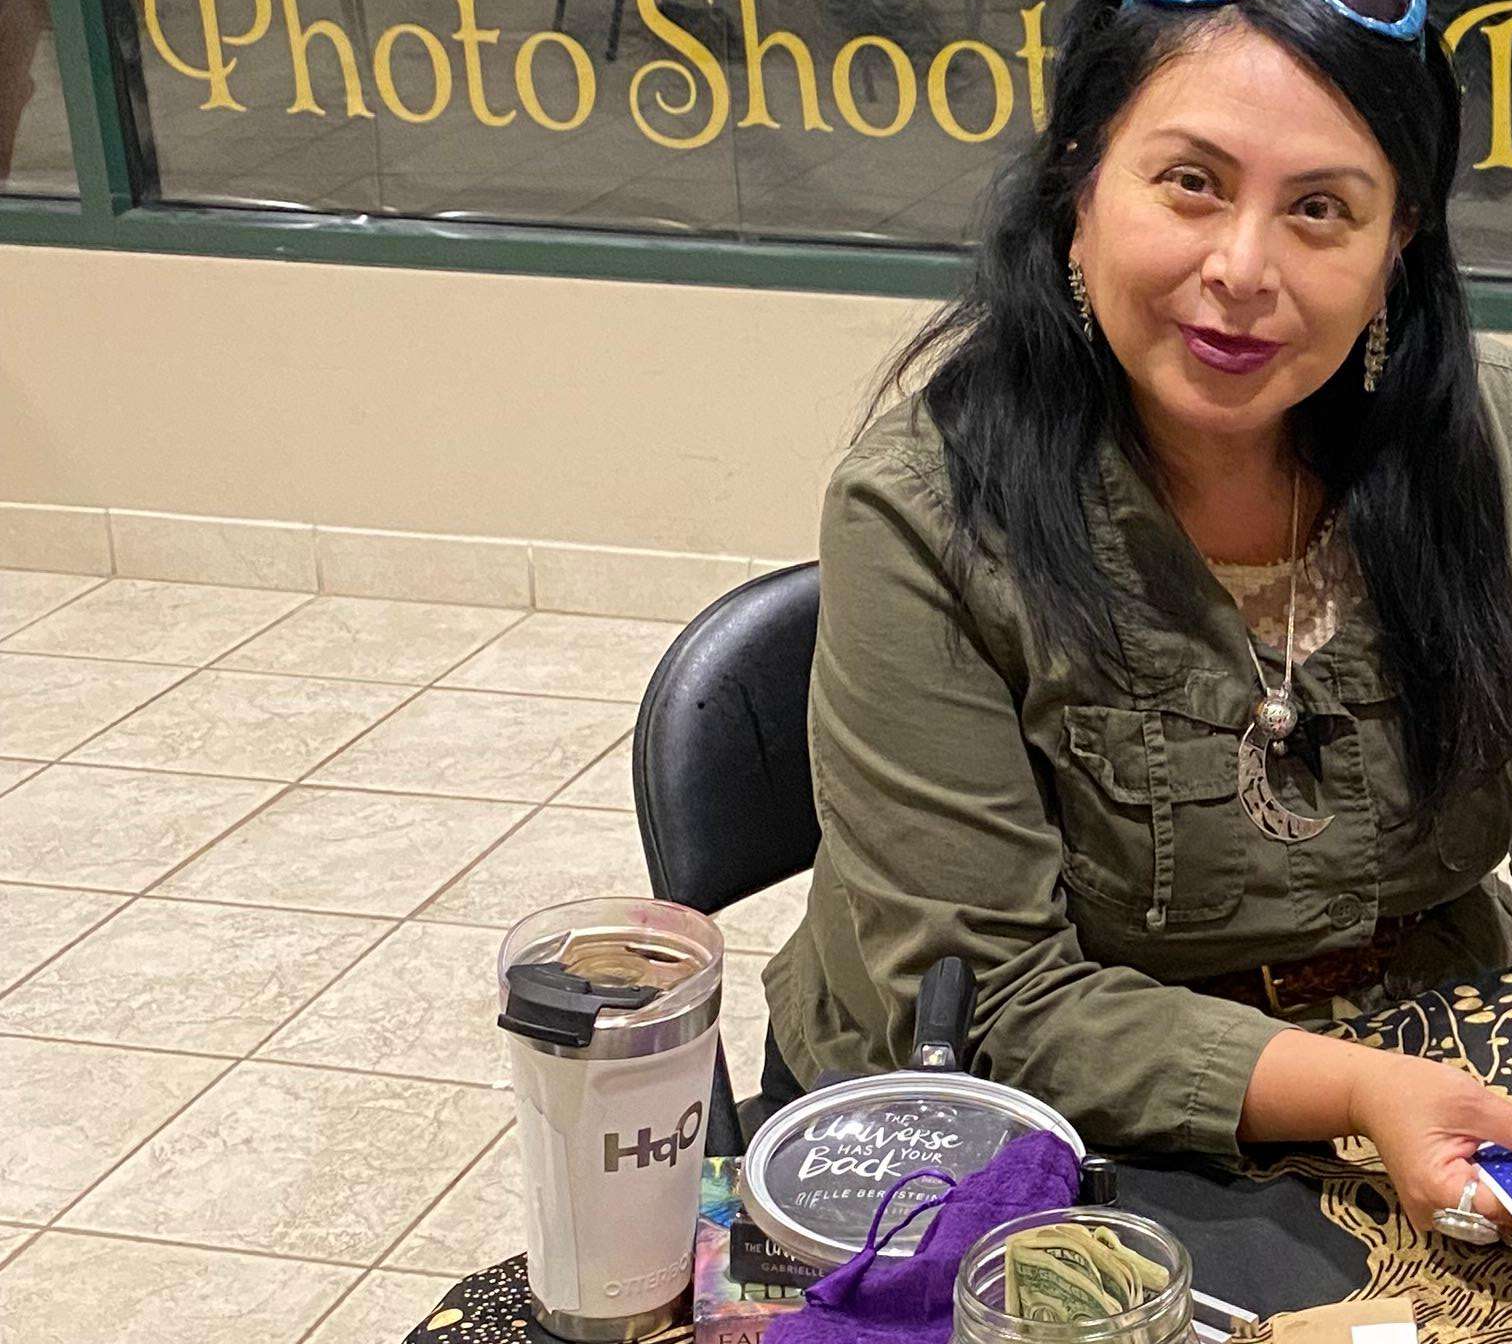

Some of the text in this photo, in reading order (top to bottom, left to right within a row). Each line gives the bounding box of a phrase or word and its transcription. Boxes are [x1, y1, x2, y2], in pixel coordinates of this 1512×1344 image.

[837, 1144, 943, 1164] HAS YOUR
[797, 1146, 902, 1181] Back
[857, 1188, 939, 1202] BERSTEIN
[744, 1242, 762, 1254] THE
[760, 1263, 825, 1277] GABRIELLE
